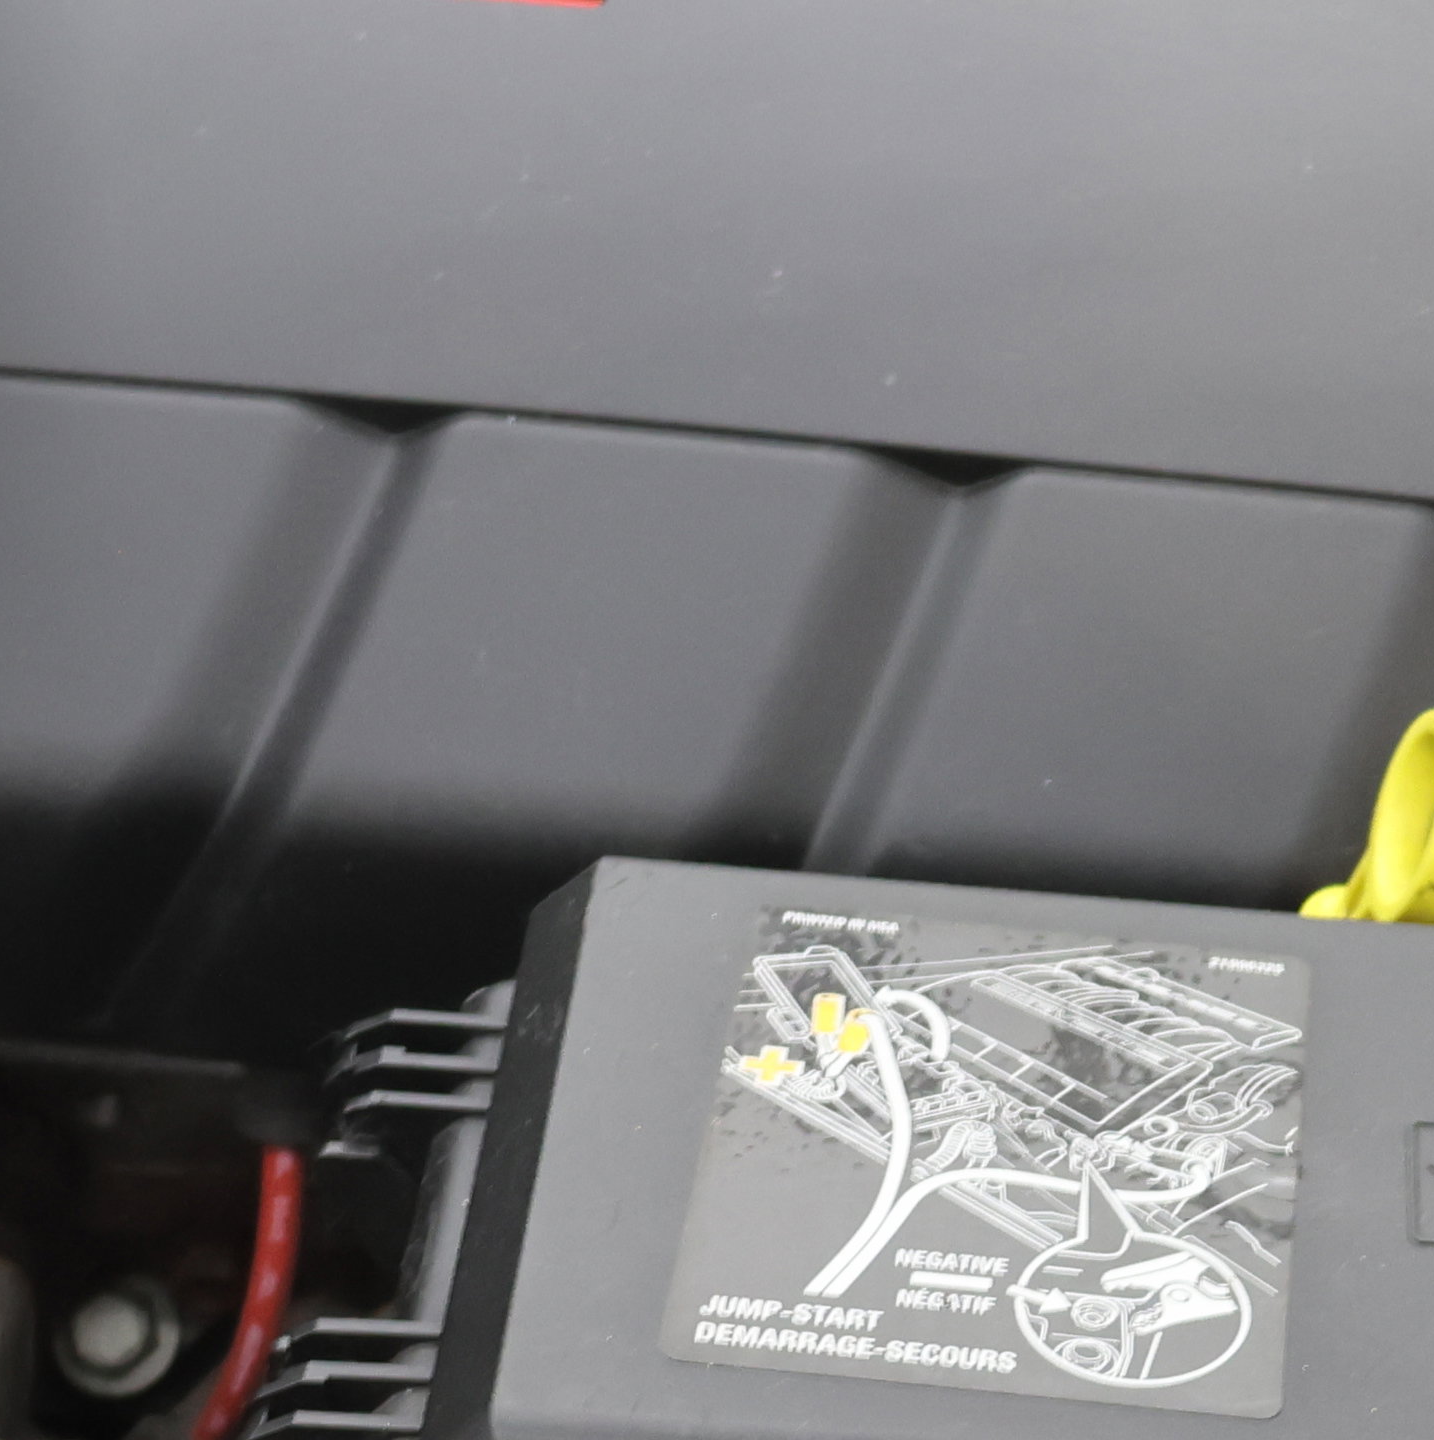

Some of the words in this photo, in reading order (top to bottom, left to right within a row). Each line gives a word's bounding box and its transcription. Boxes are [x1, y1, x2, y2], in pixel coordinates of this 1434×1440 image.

[894, 1247, 1010, 1277] NEGATIVE
[699, 1293, 885, 1333] JUMP-START
[895, 1287, 998, 1317] NÉGATIF
